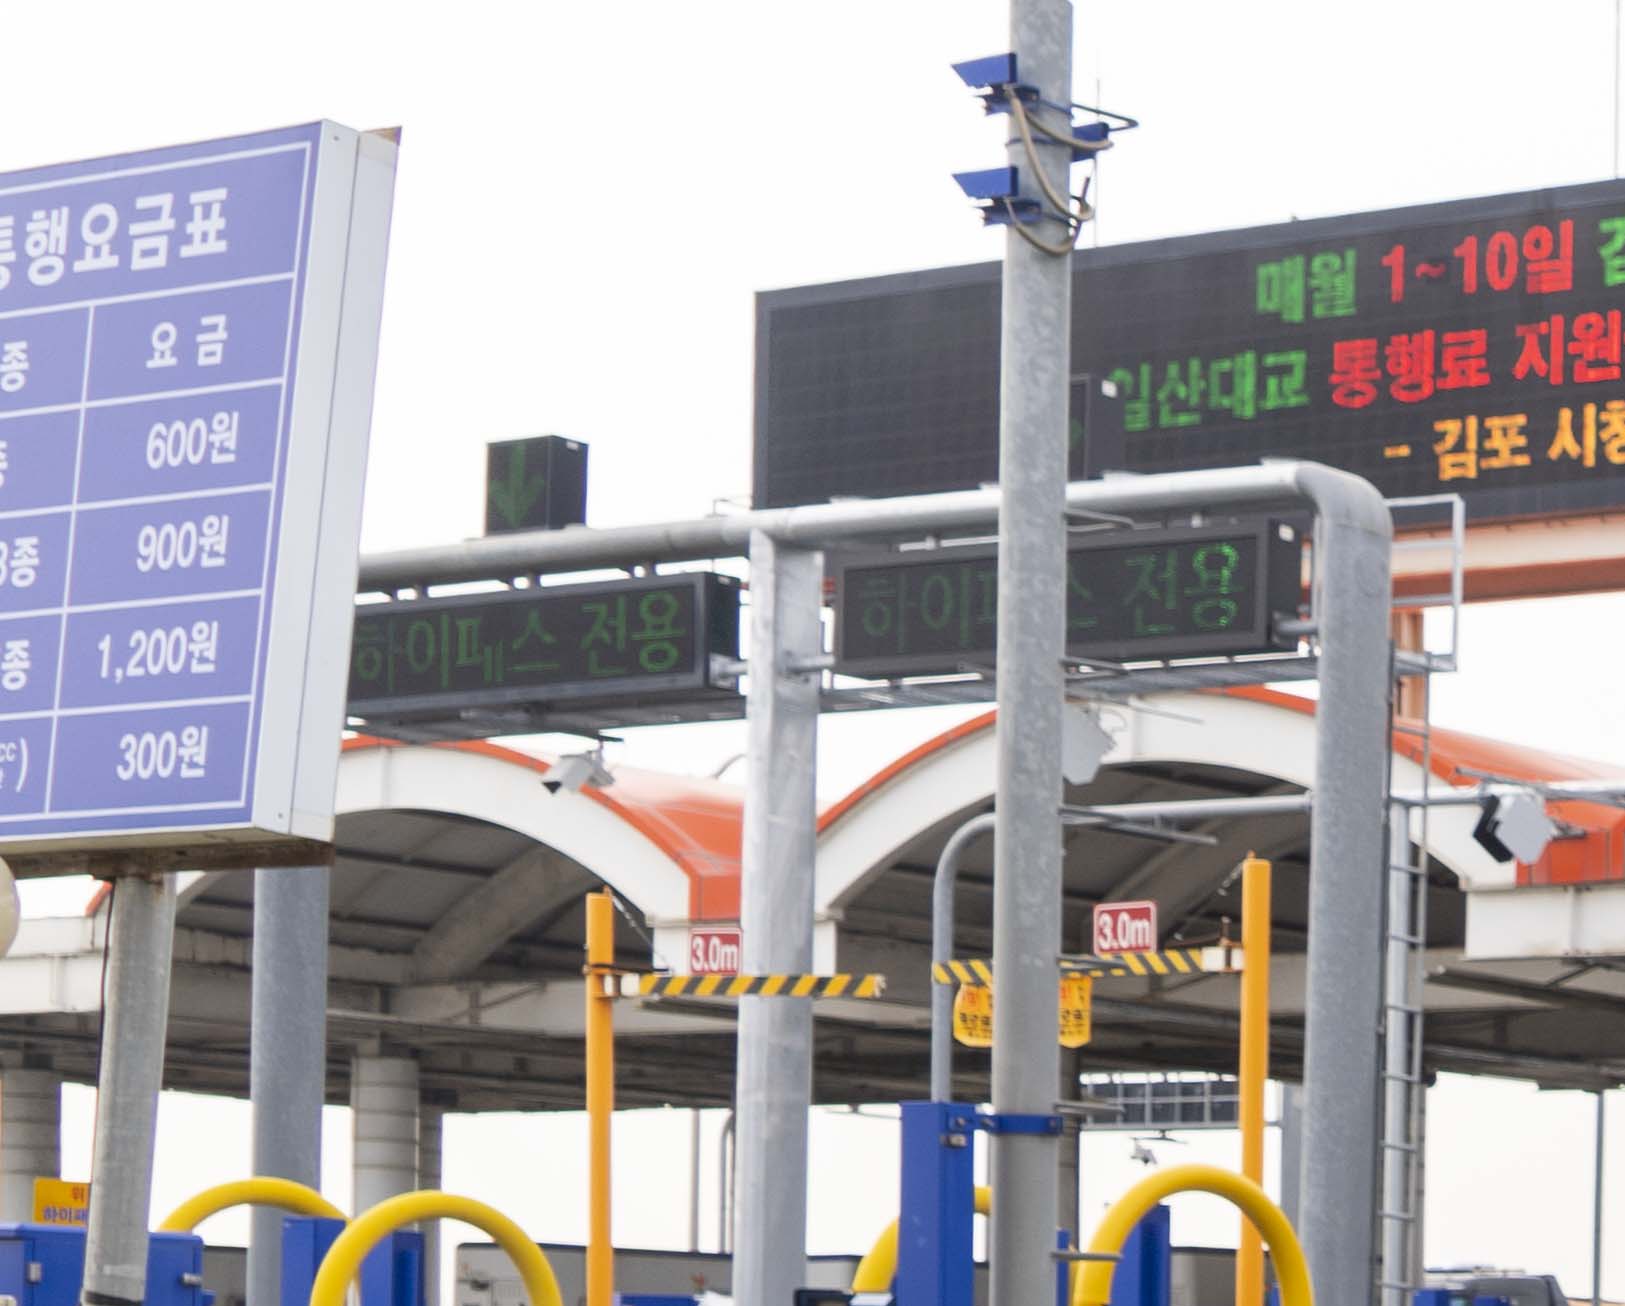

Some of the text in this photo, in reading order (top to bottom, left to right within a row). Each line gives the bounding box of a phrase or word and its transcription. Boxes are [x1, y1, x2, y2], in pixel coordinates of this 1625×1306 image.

[1256, 248, 1357, 323] 매월
[1381, 219, 1575, 304] 1~10일
[1108, 350, 1309, 432] 일산대교
[1329, 329, 1492, 409] 통행료
[147, 412, 238, 469] 600원
[1432, 412, 1532, 482] 김포
[137, 515, 229, 572] 900원
[1124, 542, 1245, 635] 전용
[98, 621, 218, 684] 1,200원
[354, 591, 687, 692] 하이패스 전용
[117, 726, 208, 780] 300원
[692, 935, 738, 972] 3.0m
[1099, 911, 1151, 950] 3.0m
